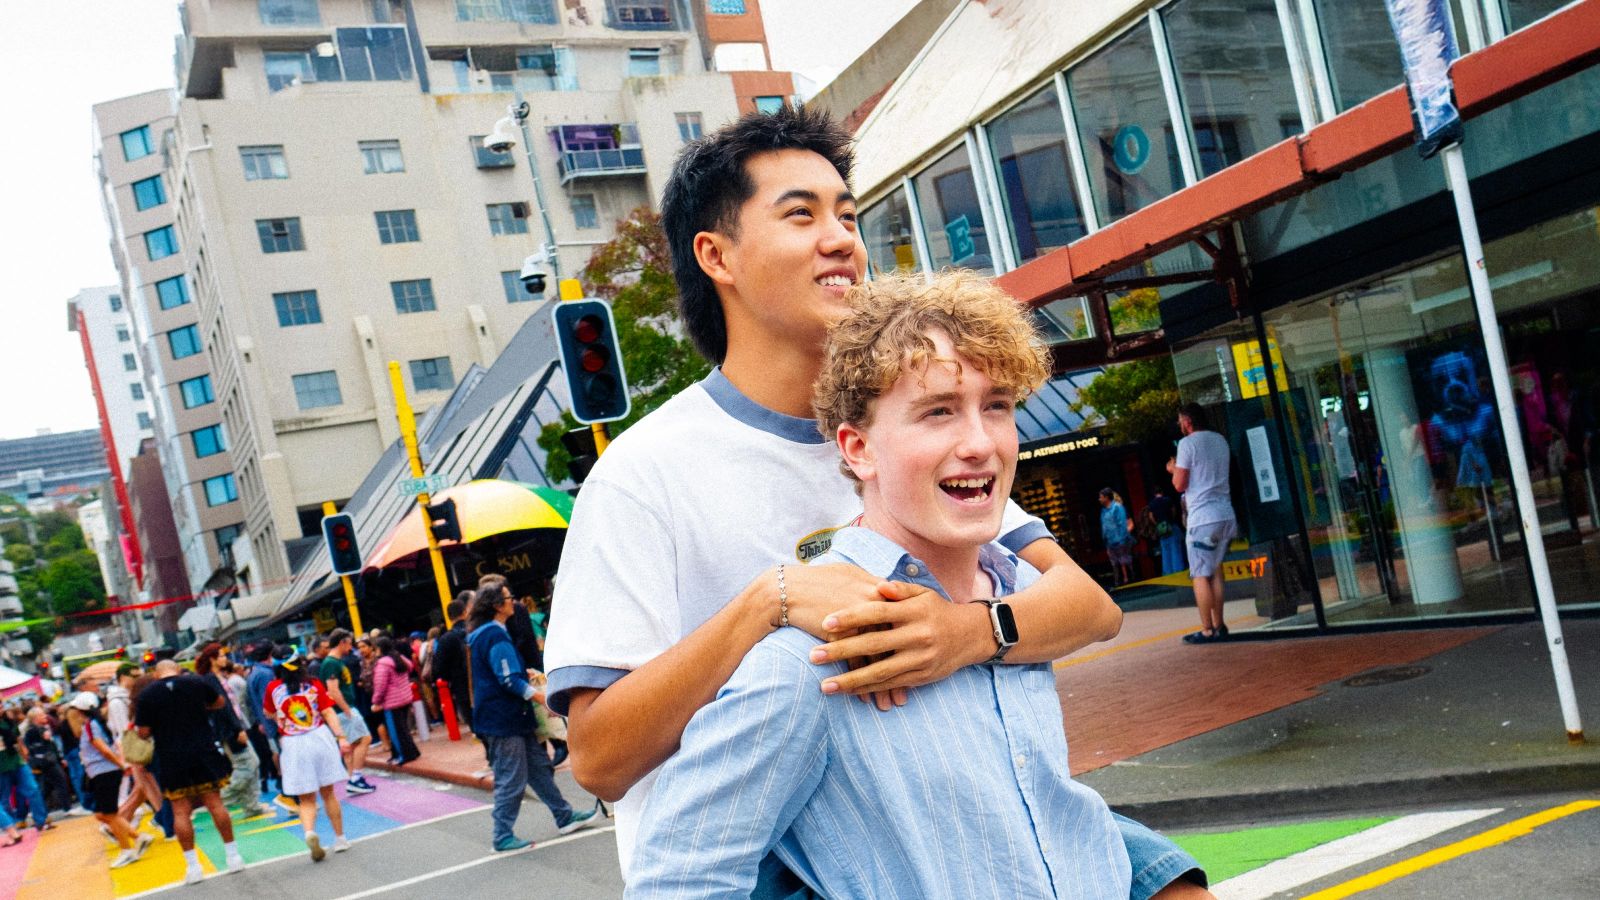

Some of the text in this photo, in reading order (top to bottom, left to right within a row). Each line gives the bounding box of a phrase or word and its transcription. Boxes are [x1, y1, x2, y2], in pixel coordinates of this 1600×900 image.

[945, 124, 1150, 263] E O
[1018, 450, 1032, 461] he
